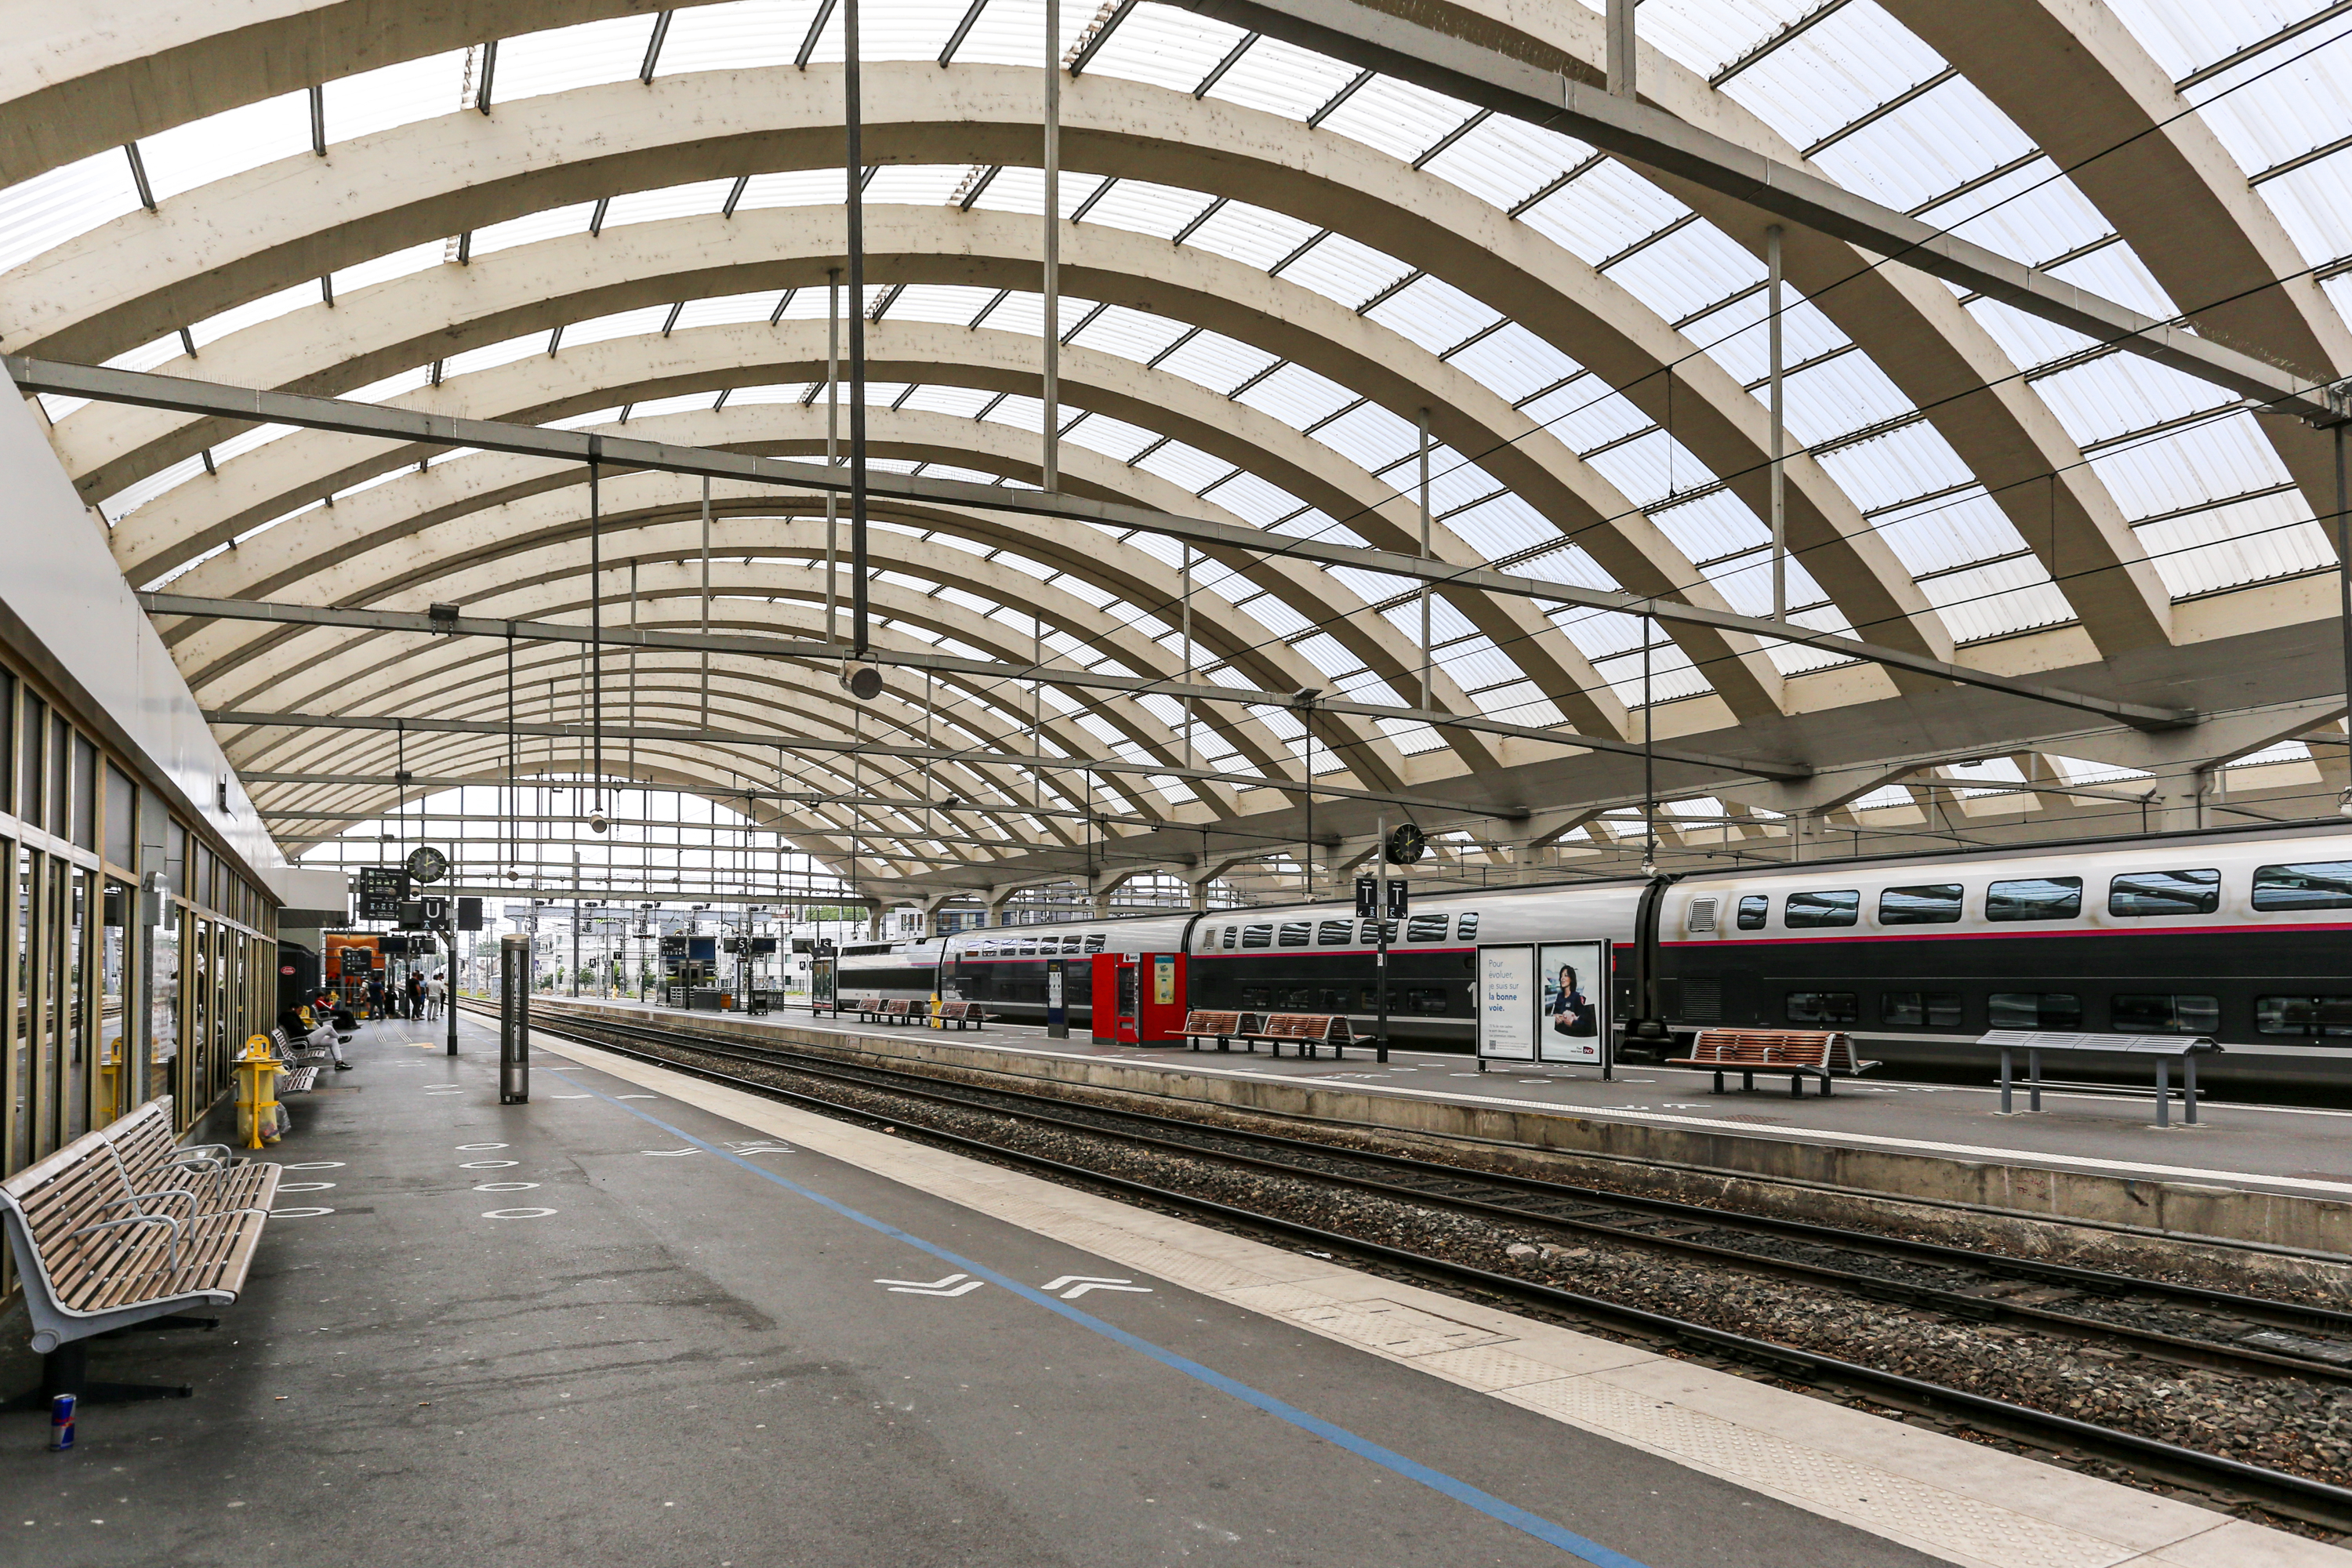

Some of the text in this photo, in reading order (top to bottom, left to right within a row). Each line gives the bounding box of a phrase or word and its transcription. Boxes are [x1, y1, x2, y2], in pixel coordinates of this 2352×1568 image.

[1362, 886, 1372, 903] T
[1392, 887, 1403, 905] T
[426, 902, 440, 918] U
[415, 938, 422, 947] T
[739, 939, 745, 949] S
[1489, 959, 1504, 967] Pour
[1489, 971, 1513, 979] évoluer,
[1488, 982, 1494, 991] je
